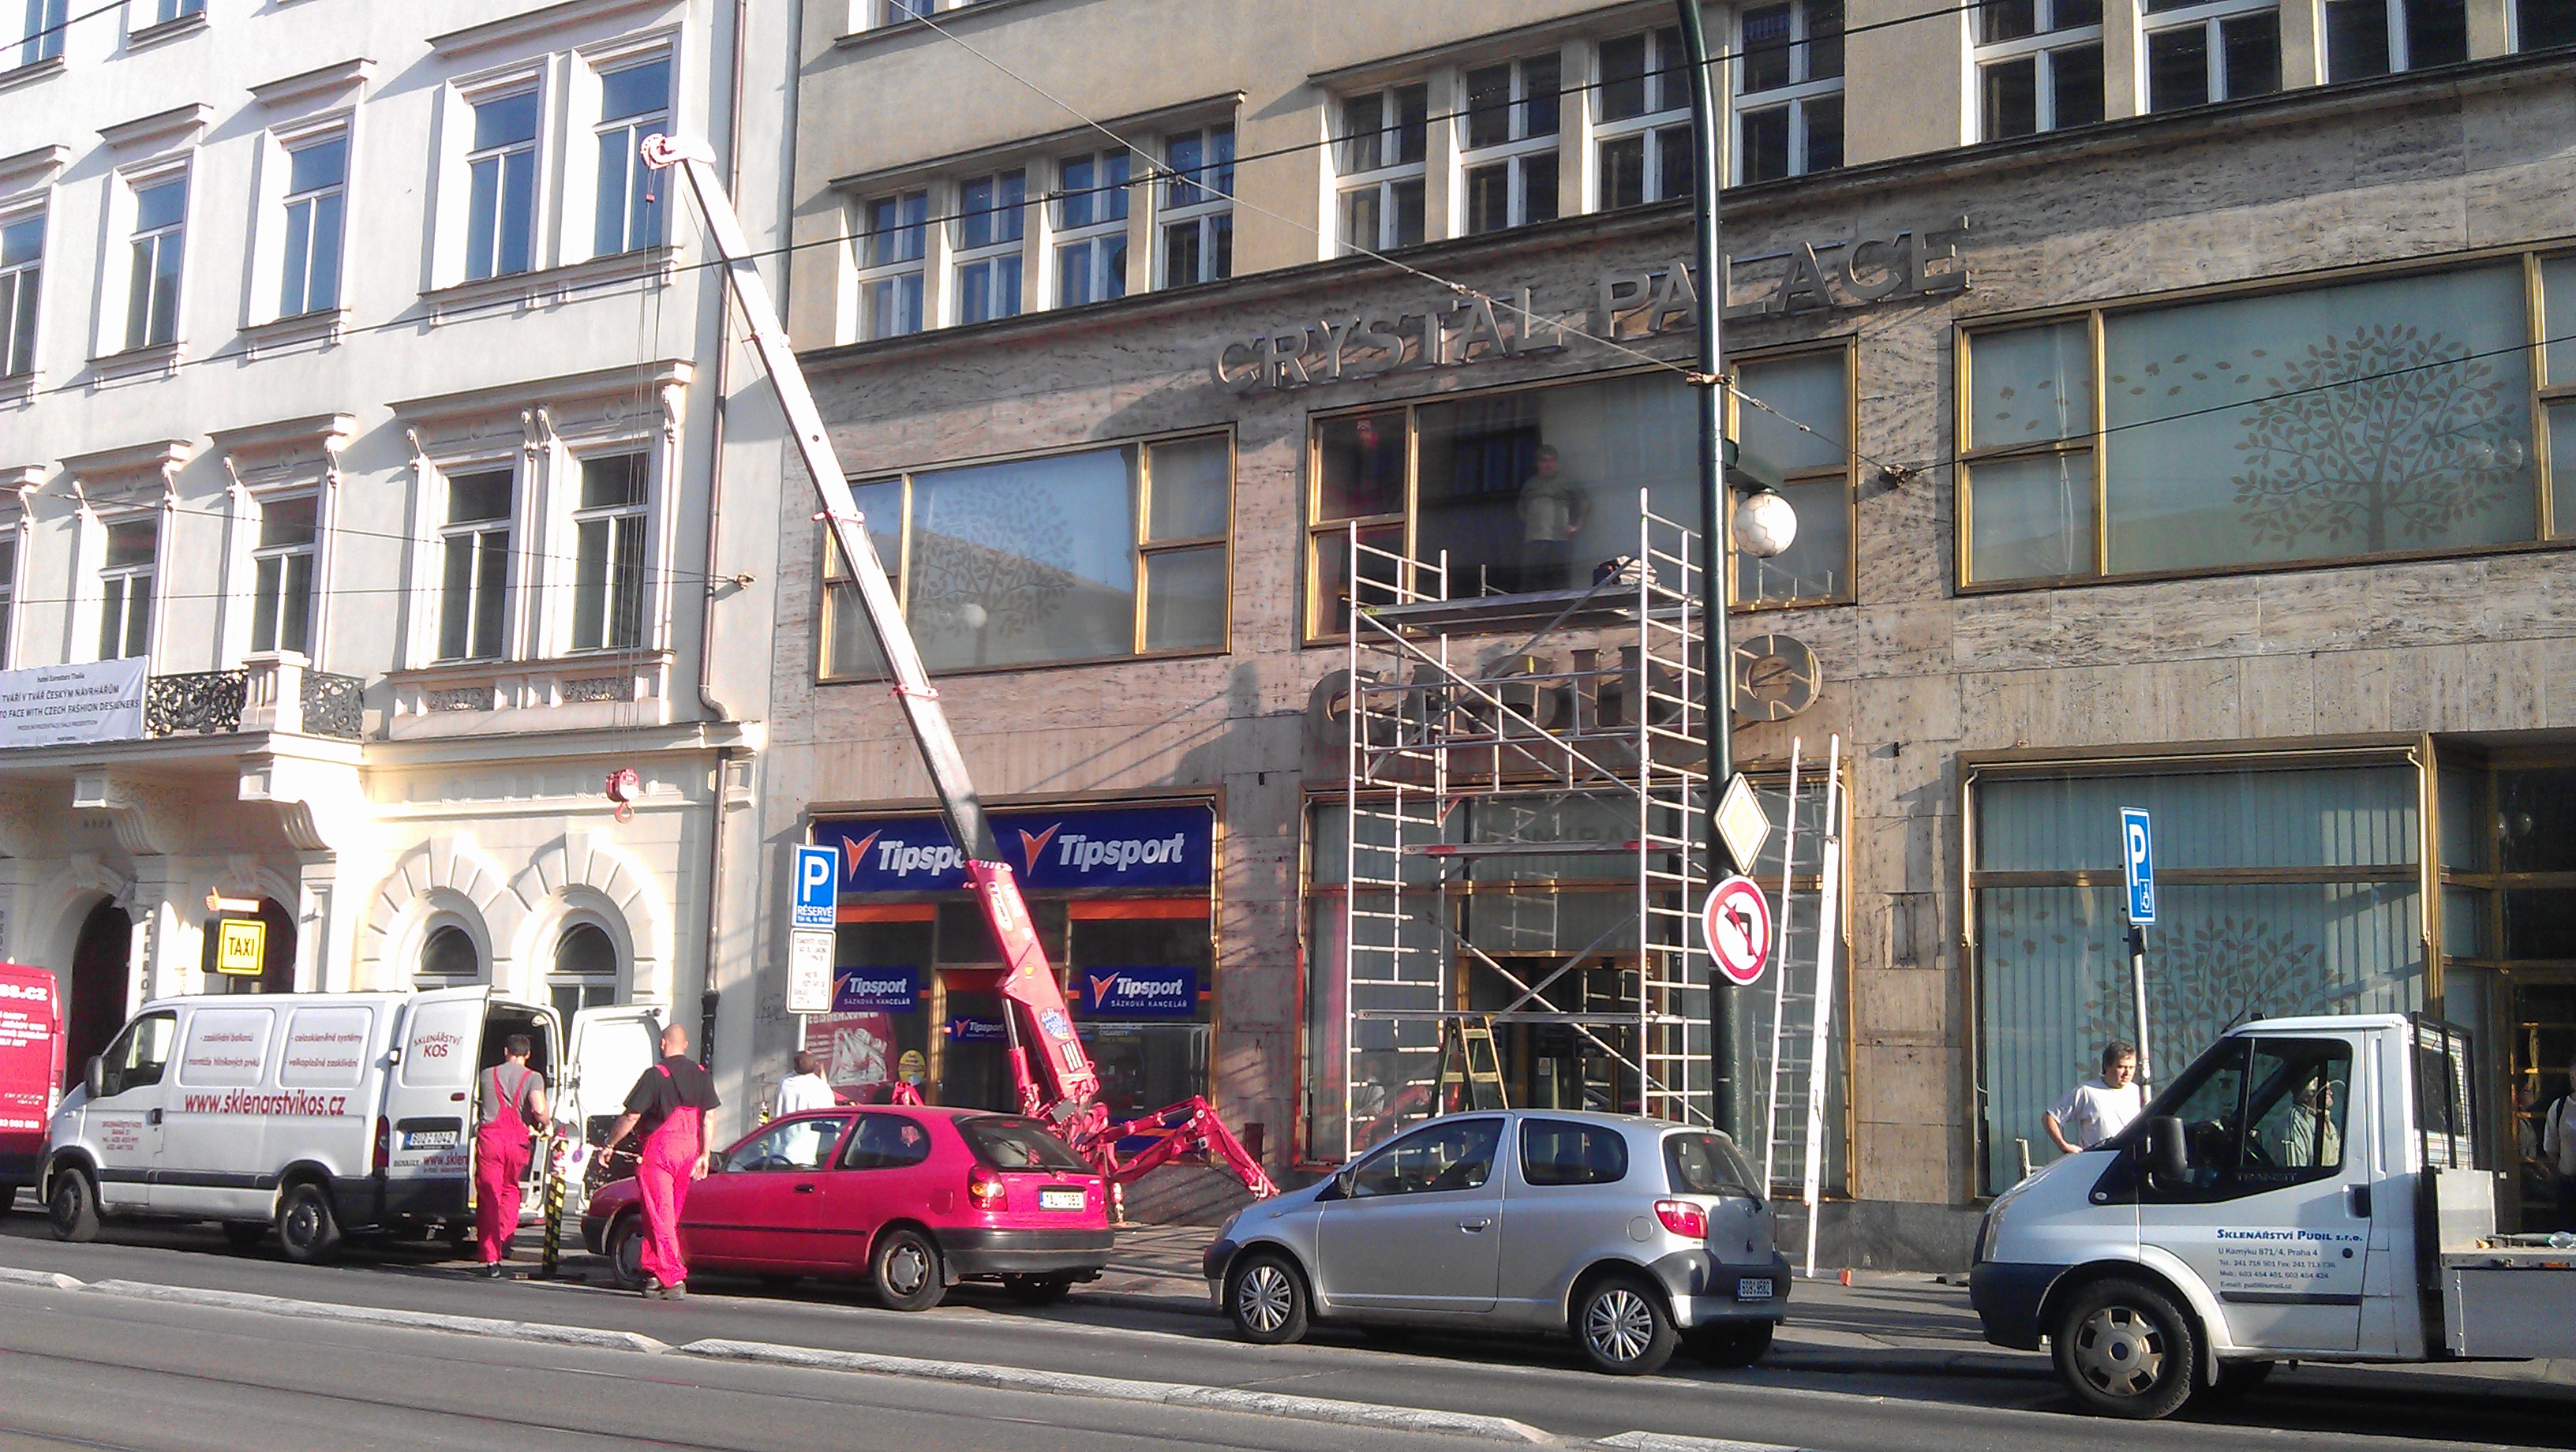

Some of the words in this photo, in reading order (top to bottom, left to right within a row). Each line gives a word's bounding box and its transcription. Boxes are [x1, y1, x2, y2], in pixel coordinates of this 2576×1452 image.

[1211, 286, 1563, 394] CRYSTAL
[1598, 215, 1971, 339] PALACE
[9, 709, 25, 718] FACE
[26, 708, 43, 717] WITH
[44, 705, 66, 716] CZECH
[68, 702, 98, 713] FASHION
[99, 699, 140, 711] DESIGNERS
[878, 840, 965, 877] Tipspo
[1058, 833, 1185, 872] Tipsport
[2129, 824, 2146, 887] P
[803, 855, 829, 902] P
[797, 904, 833, 917] RÉSERVÉ
[229, 937, 255, 956] TAXI
[850, 978, 908, 997] Tipsport
[1117, 978, 1183, 998] Tipsport
[1110, 998, 1144, 1007] SÁZKOVÁ
[1148, 999, 1188, 1008] KANCELÁŘ
[970, 1021, 1005, 1033] Tipsport
[414, 1031, 463, 1046] SKLENÁŘSTVÍ
[423, 1044, 448, 1057] KOS
[185, 1088, 346, 1116] www.sklenarstvikos.cz
[2217, 1229, 2293, 1240] SKLENÁŘSTVÍ
[2297, 1230, 2332, 1241] PUDIL
